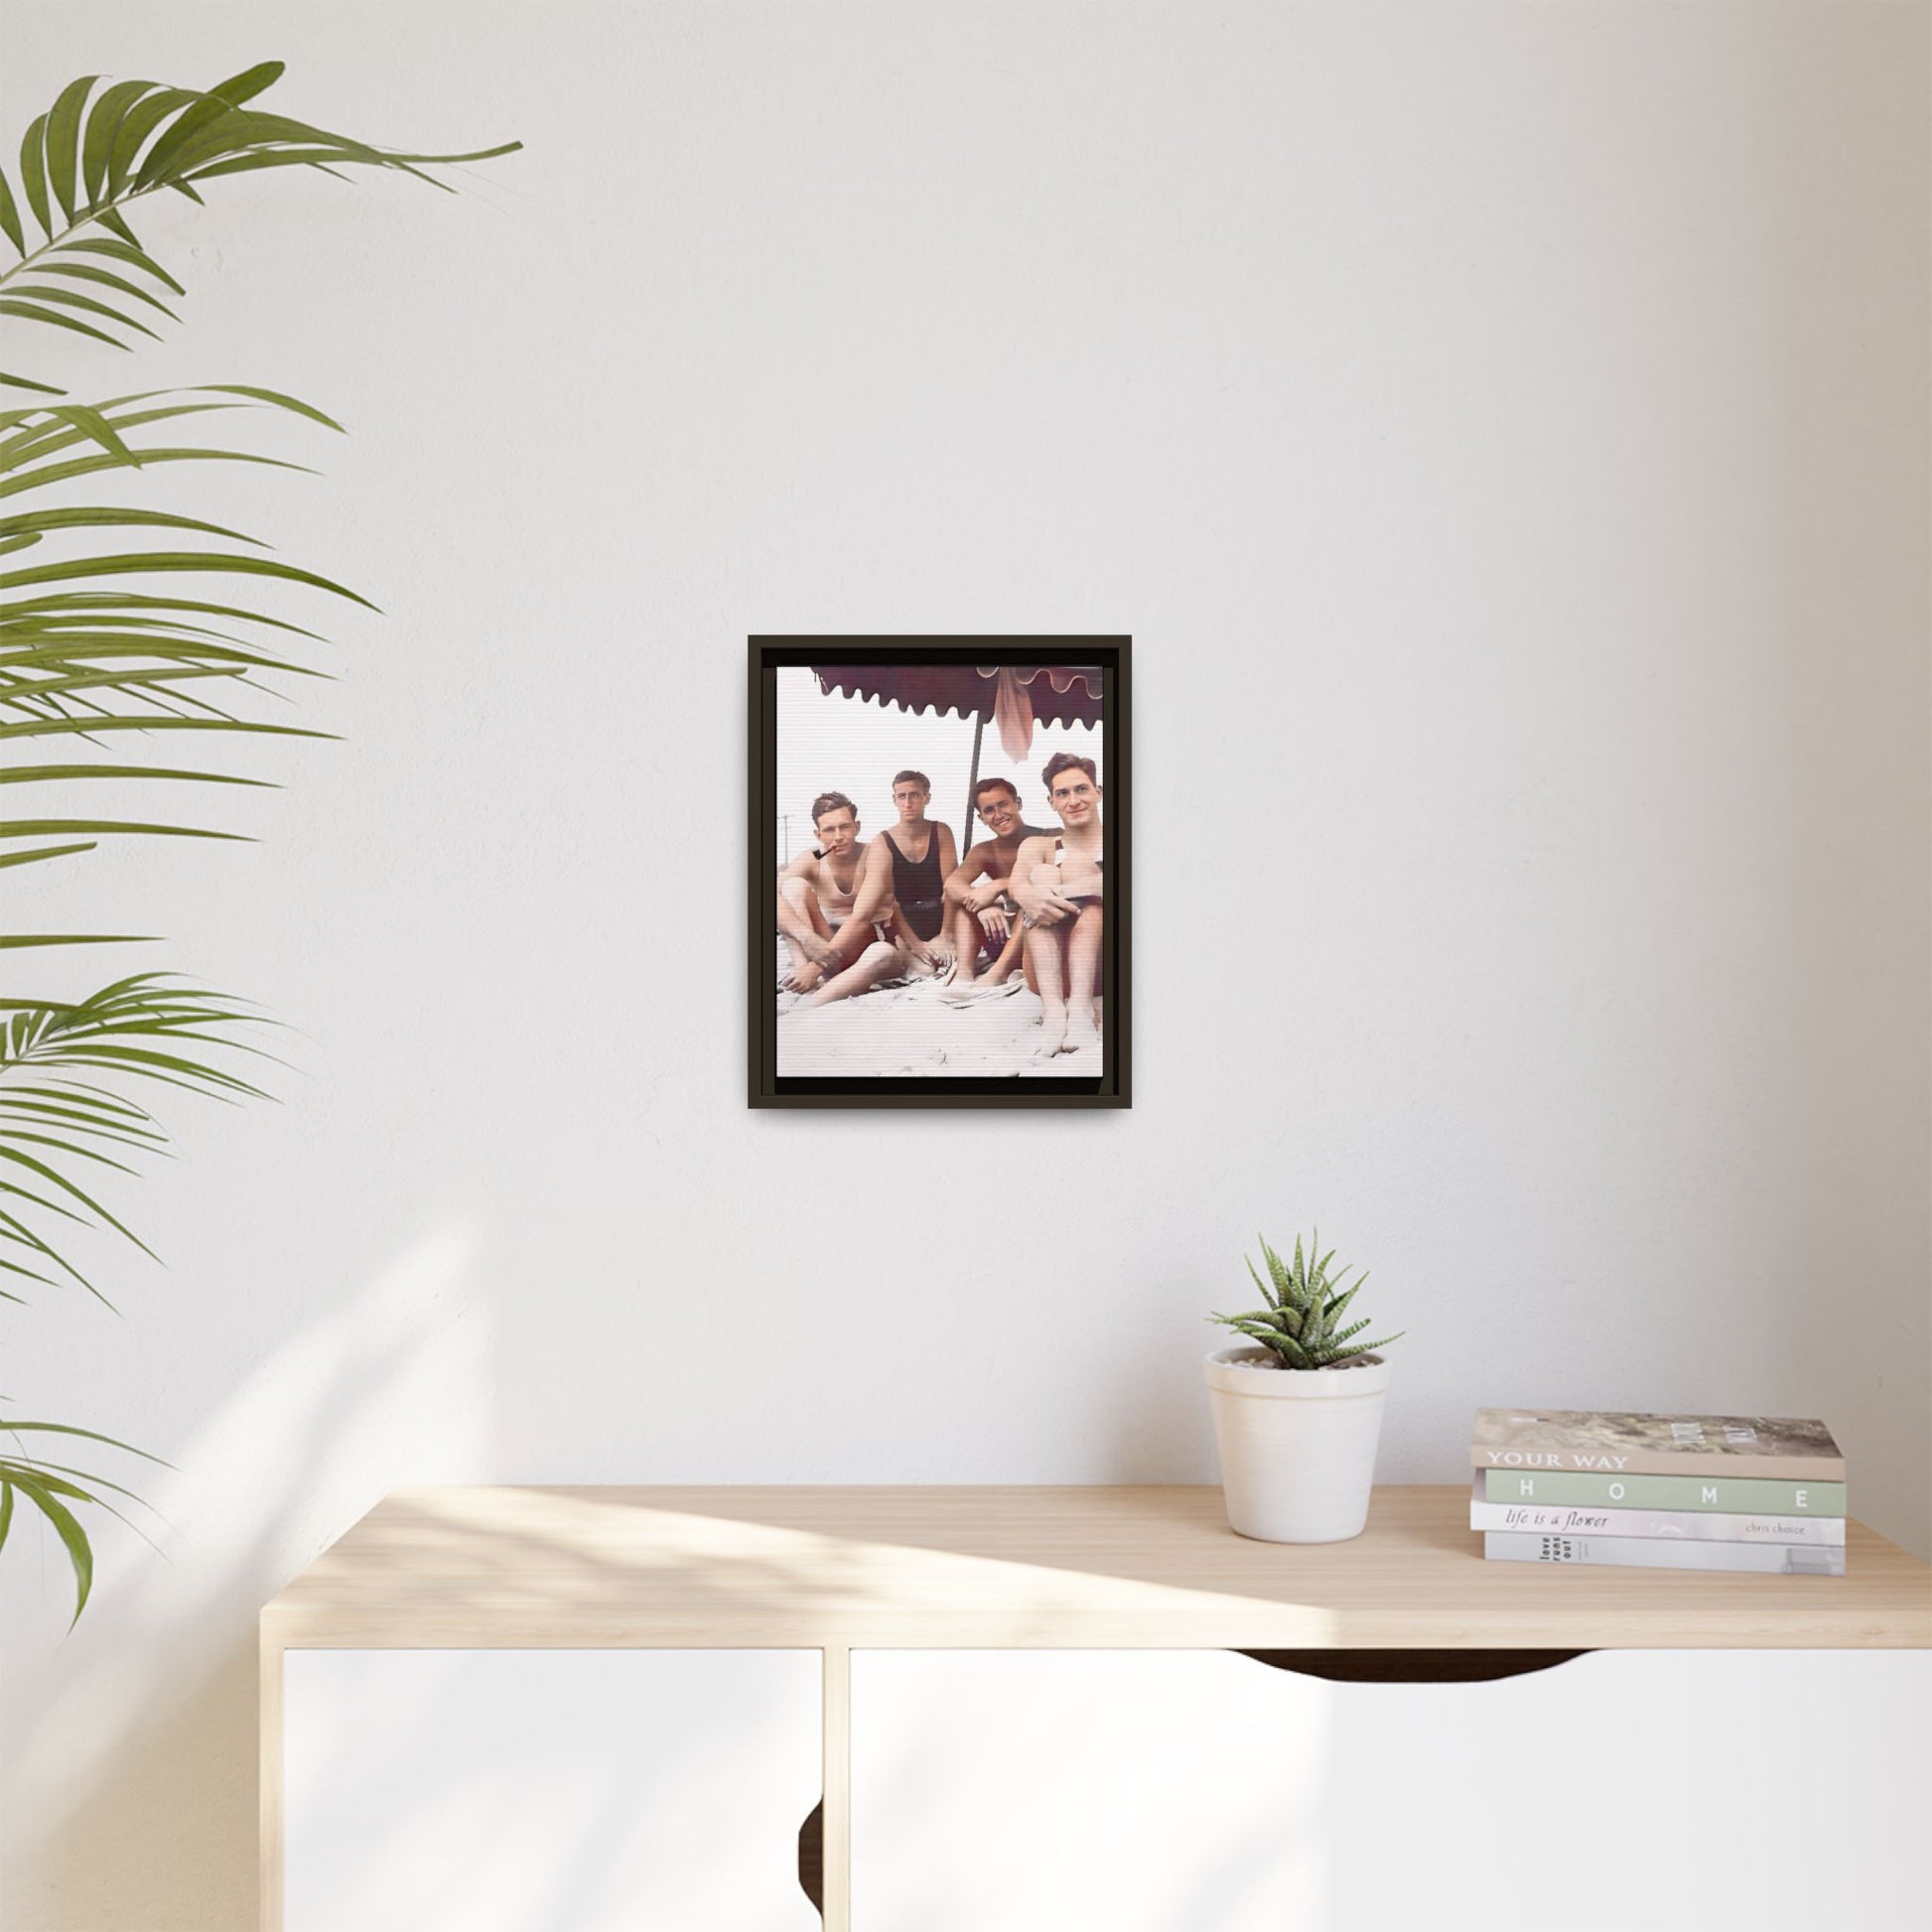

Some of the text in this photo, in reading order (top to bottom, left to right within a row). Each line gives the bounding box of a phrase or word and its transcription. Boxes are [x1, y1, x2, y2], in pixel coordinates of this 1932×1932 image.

[1487, 1451, 1628, 1469] YOUR WAY
[1506, 1509, 1609, 1531] life is a flower
[1745, 1521, 1805, 1535] chris choice
[1540, 1537, 1550, 1561] love
[1563, 1540, 1572, 1559] out
